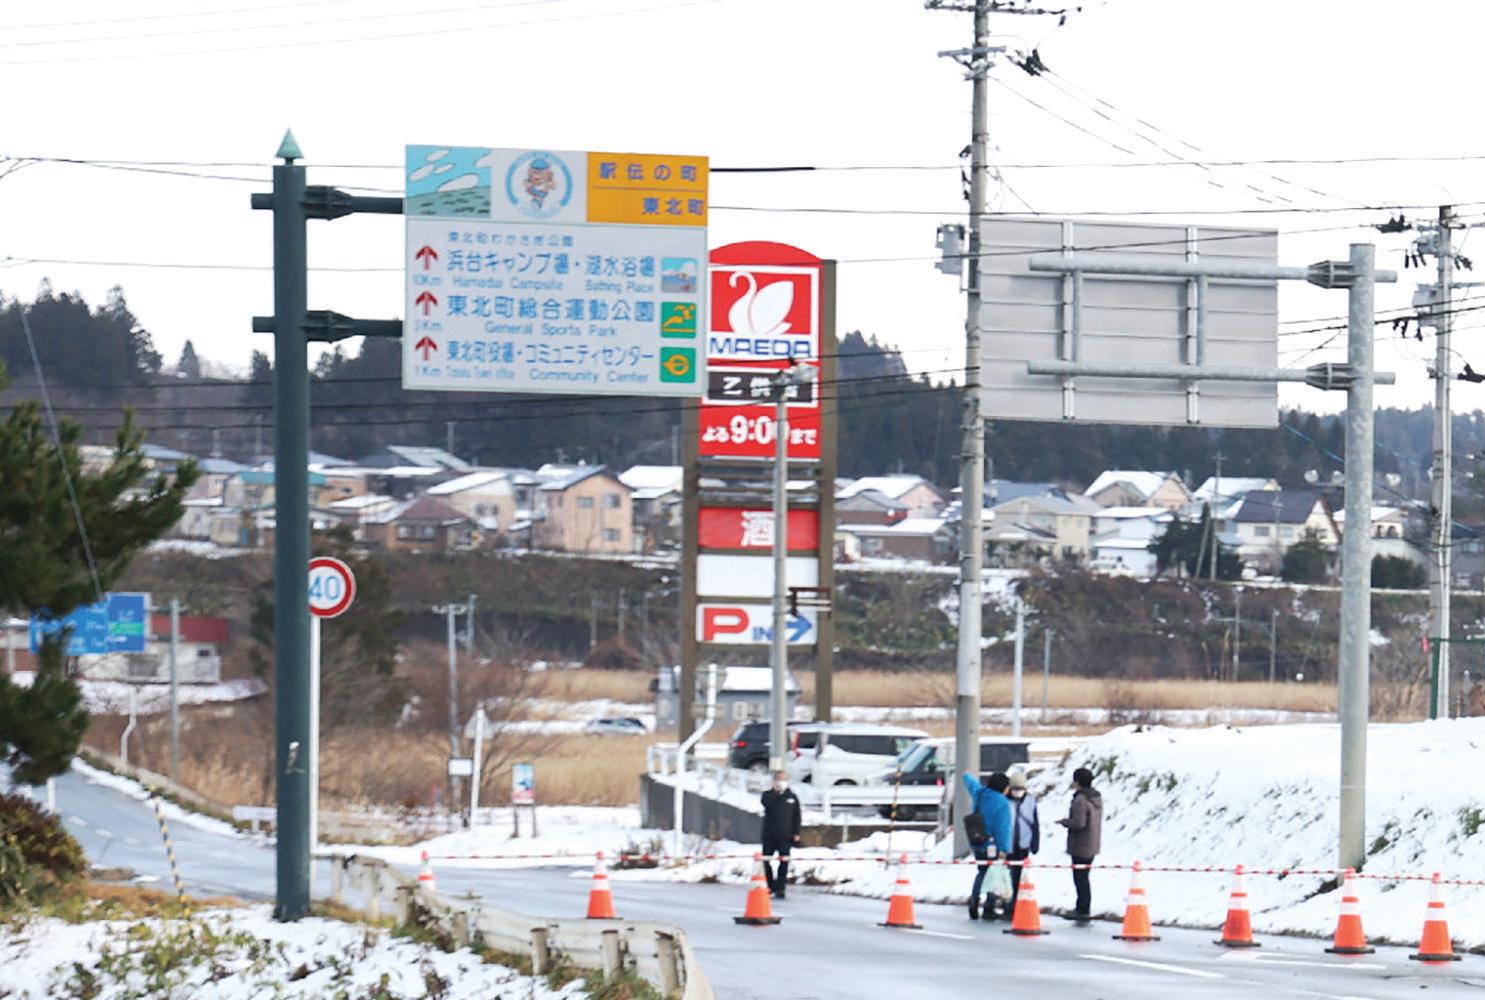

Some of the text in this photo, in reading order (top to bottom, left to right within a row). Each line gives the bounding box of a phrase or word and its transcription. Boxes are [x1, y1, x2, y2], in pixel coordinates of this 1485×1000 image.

[642, 197, 704, 215] 東北町
[447, 295, 655, 322] 東北町総合運動公園
[710, 337, 811, 357] MAEDA
[308, 575, 341, 600] 40
[703, 607, 749, 641] P
